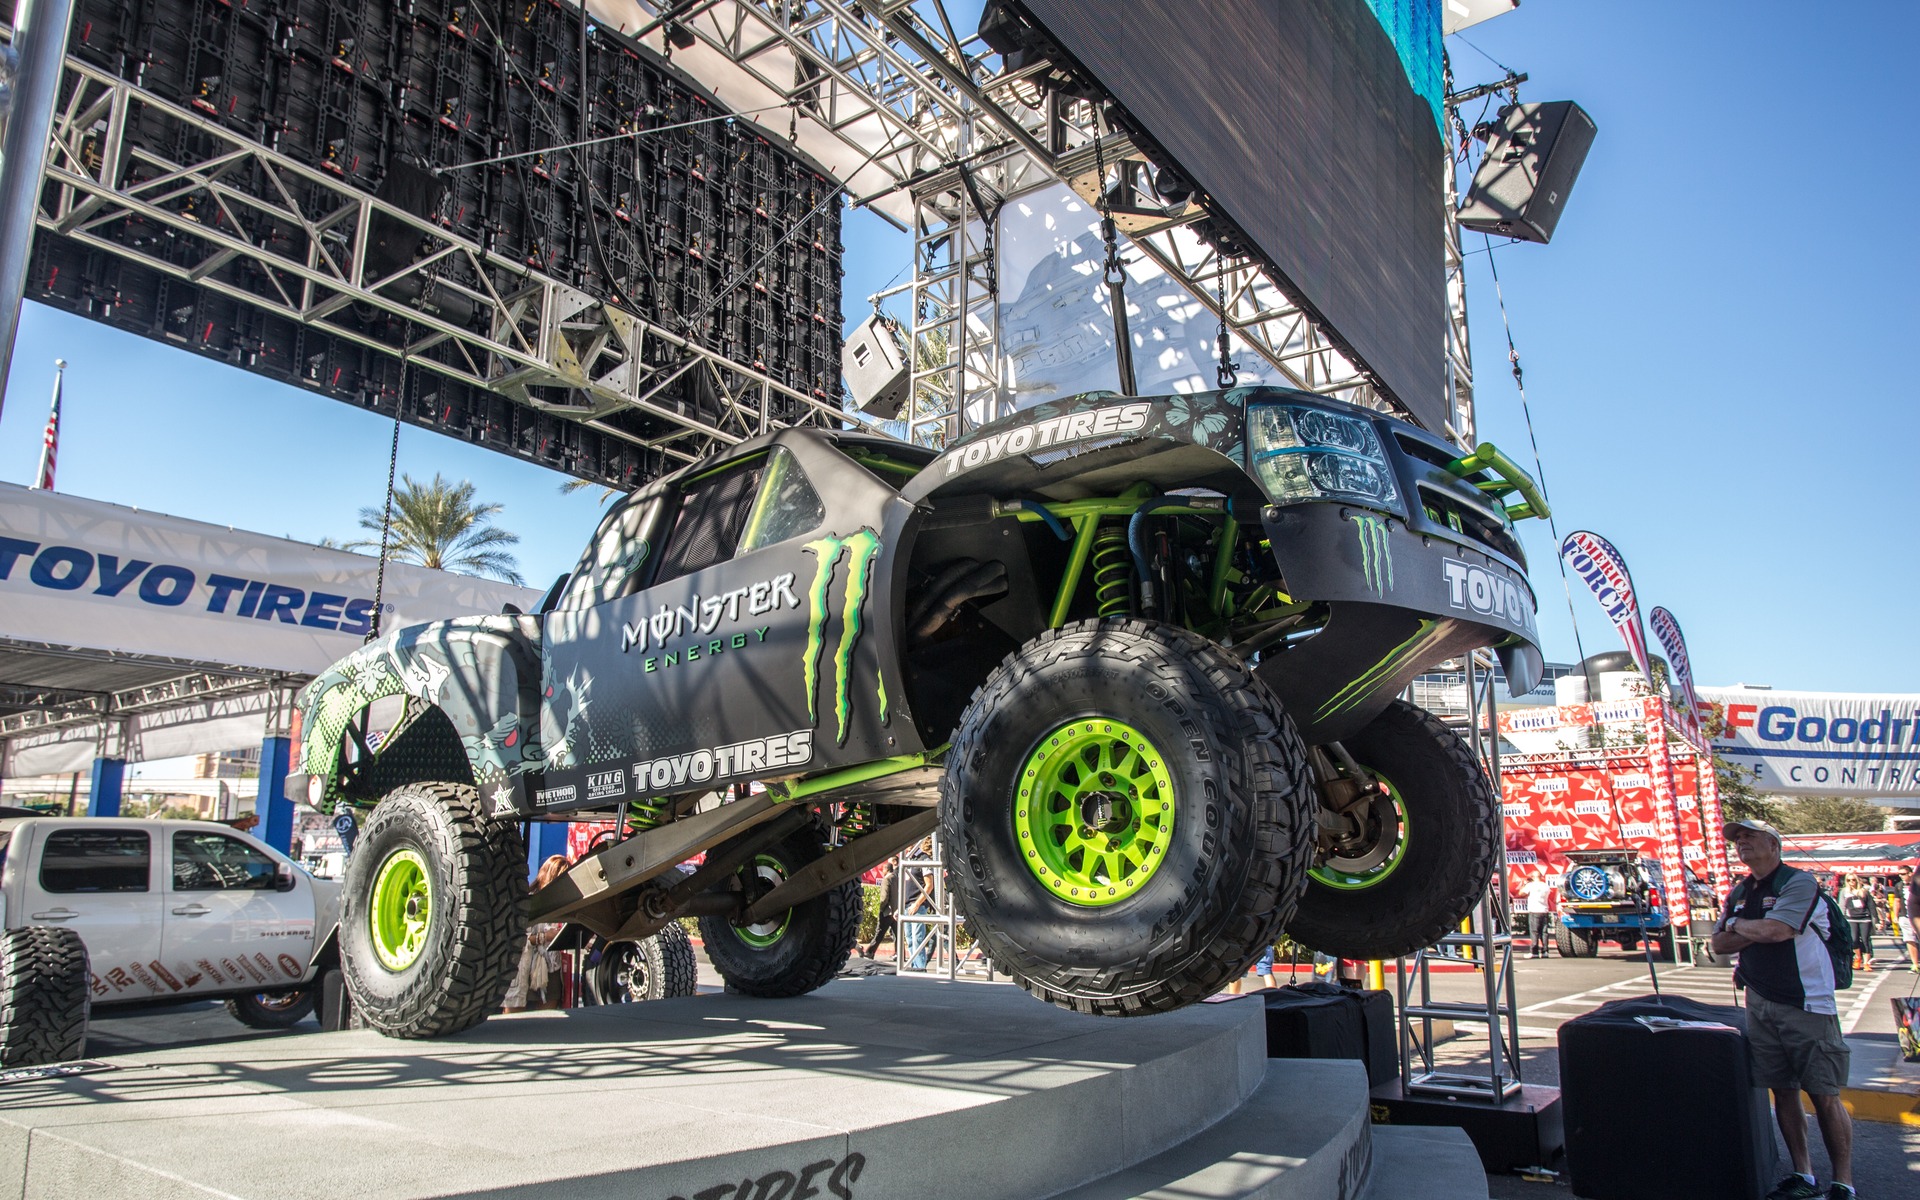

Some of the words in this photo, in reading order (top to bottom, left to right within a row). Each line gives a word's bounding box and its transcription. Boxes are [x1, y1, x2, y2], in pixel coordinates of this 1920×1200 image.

[946, 424, 1036, 477] TOYO
[1036, 403, 1151, 448] TIRES
[0, 536, 196, 606] TOYO
[206, 573, 384, 636] TIRES
[1443, 557, 1523, 626] TOYO
[1562, 539, 1631, 625] FORCE
[1573, 533, 1637, 612] AMERICAN
[621, 571, 800, 654] MONSTER
[645, 626, 769, 673] ENERGY
[1651, 613, 1689, 682] FORCE
[1145, 679, 1213, 764] OPEN
[1515, 715, 1559, 729] FORCE
[1595, 709, 1643, 722] FORCE
[536, 787, 574, 800] METHOD
[588, 771, 621, 788] KING
[633, 749, 714, 792] TOYO
[714, 729, 813, 778] TIRES
[365, 812, 407, 845] TOYO
[1504, 808, 1528, 816] ORCE
[962, 796, 999, 906] TOYO
[1149, 776, 1218, 944] COUNTRY
[1507, 855, 1537, 863] FORCE
